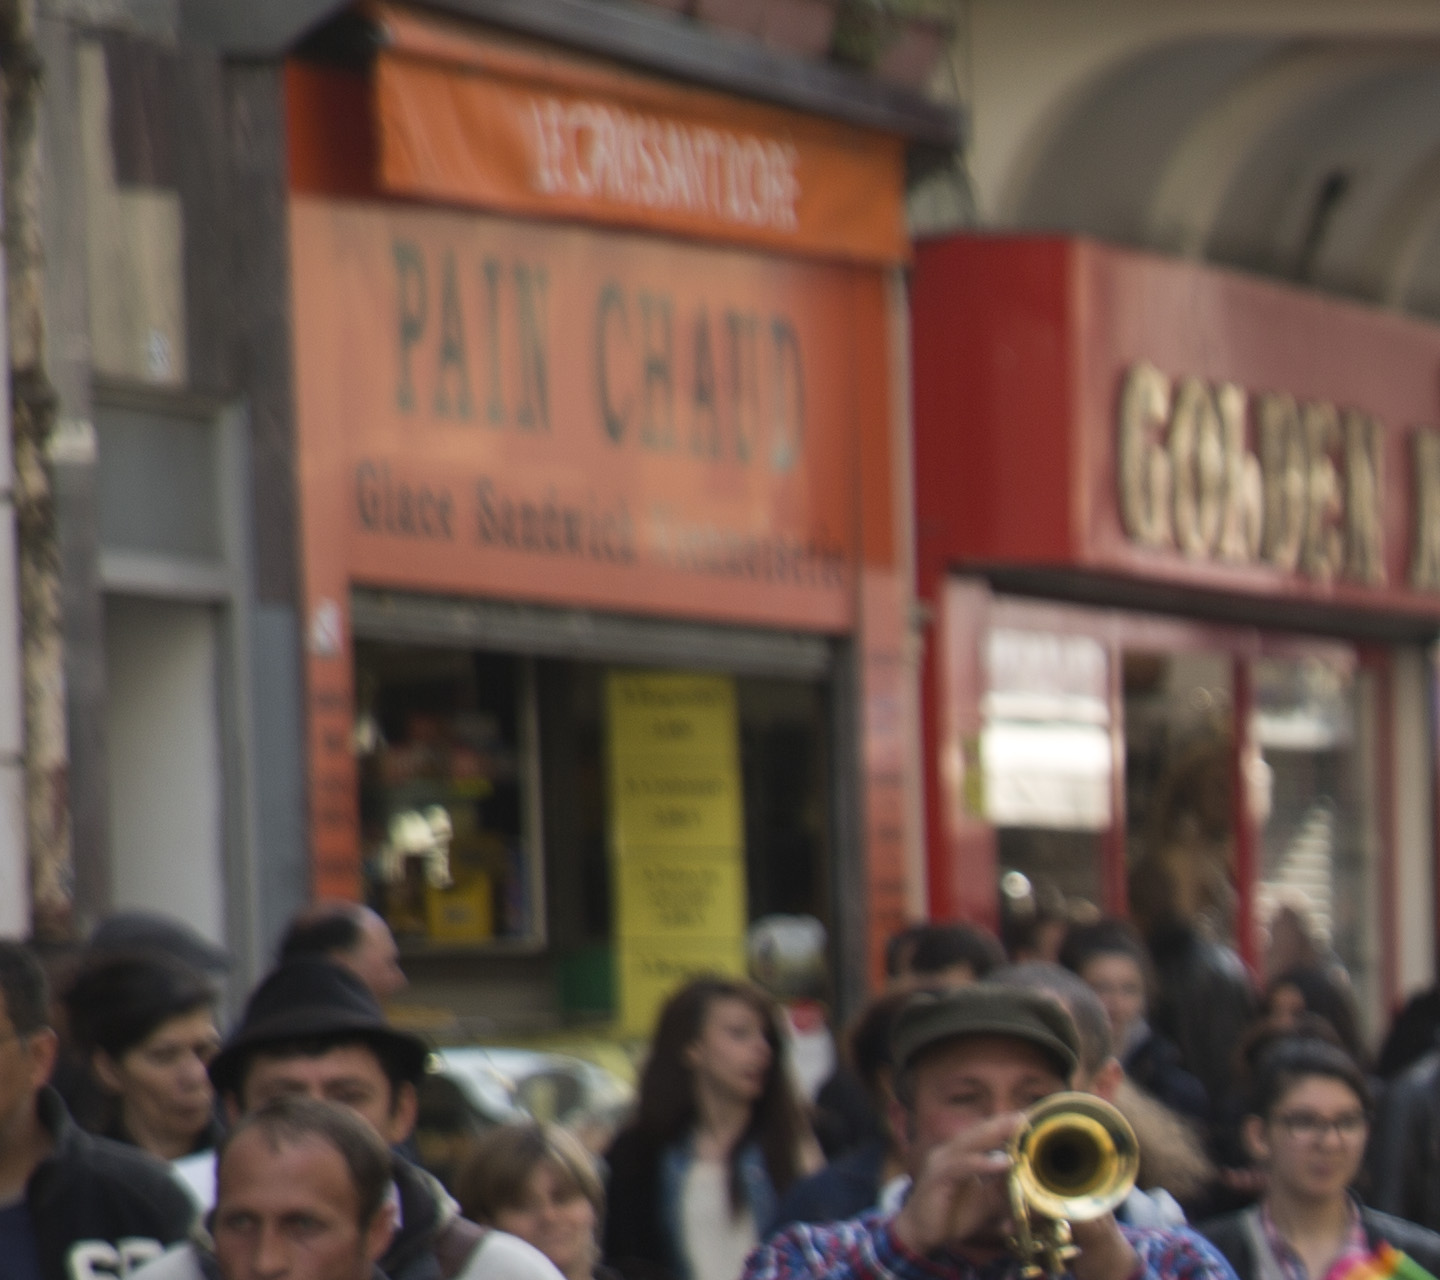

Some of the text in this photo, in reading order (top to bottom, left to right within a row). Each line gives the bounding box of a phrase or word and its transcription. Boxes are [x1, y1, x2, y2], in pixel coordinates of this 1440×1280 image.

[392, 238, 806, 476] PAIN CHAUD
[355, 460, 456, 544] Glace
[475, 476, 639, 568] Sandwich
[1116, 358, 1389, 594] GOLDEN
